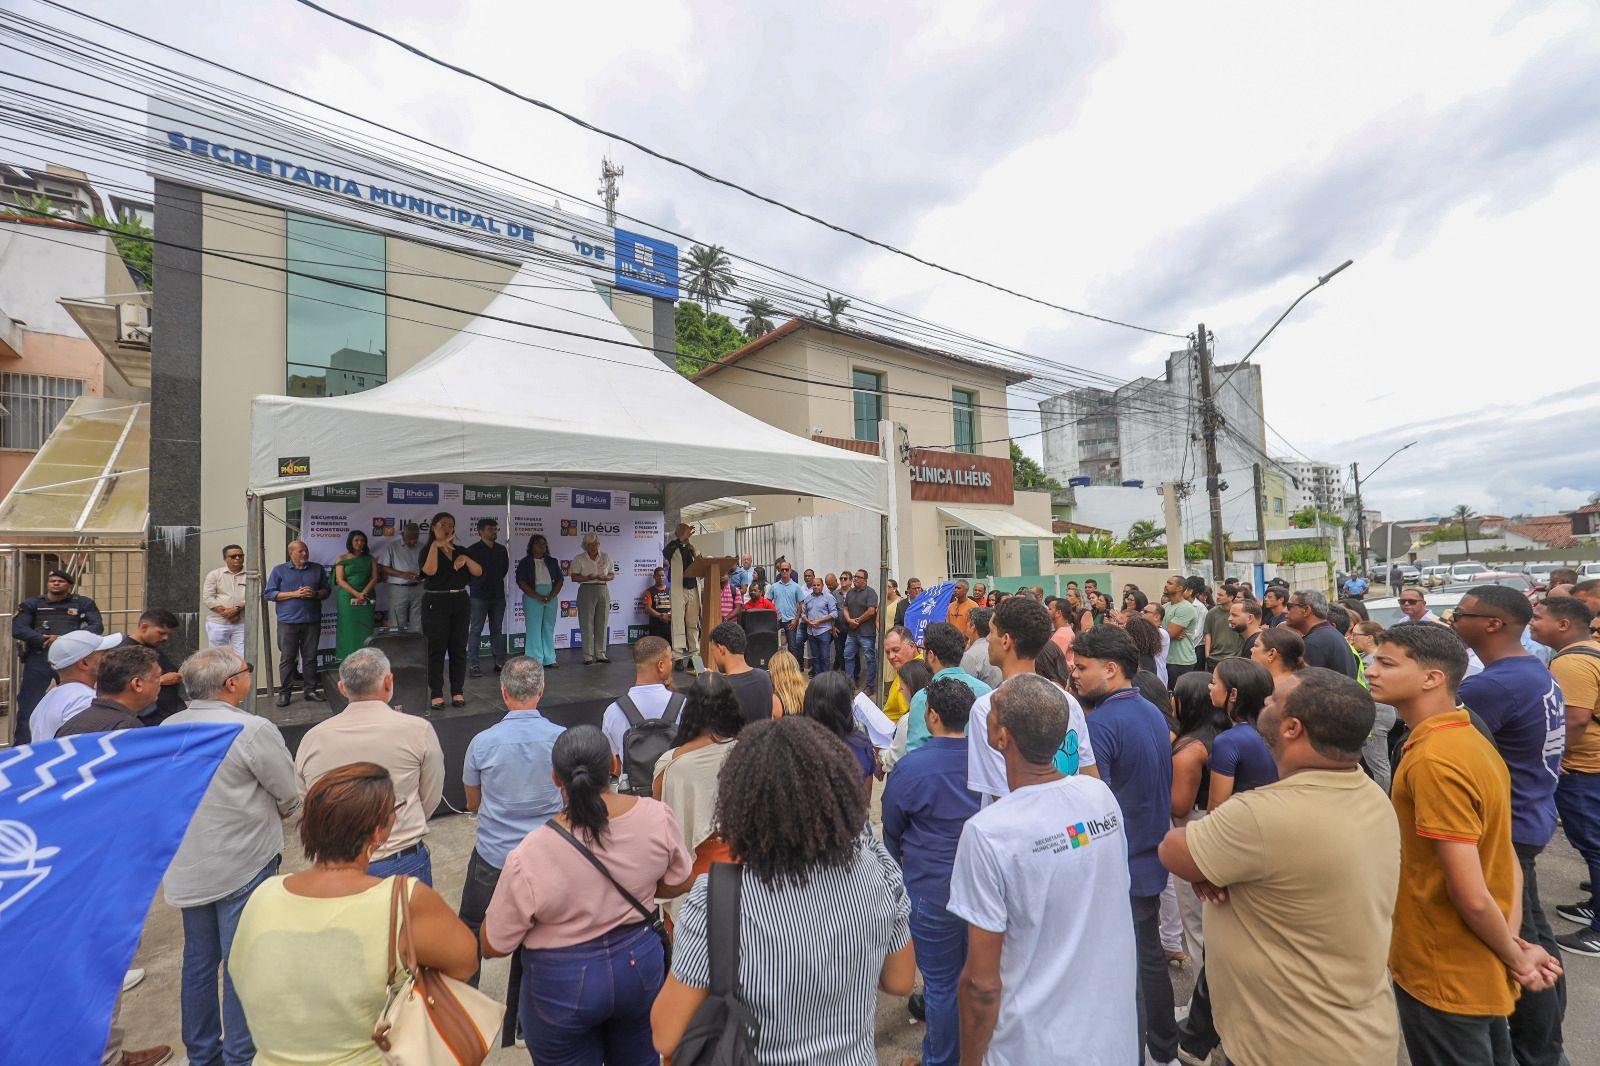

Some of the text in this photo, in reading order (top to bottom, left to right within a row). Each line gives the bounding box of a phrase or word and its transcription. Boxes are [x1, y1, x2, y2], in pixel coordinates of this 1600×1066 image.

[167, 131, 362, 198] SECRETARIA
[369, 184, 500, 233] MUNICIPAL
[507, 221, 535, 242] DE
[909, 460, 992, 487] CLÍNICA ILHÉUS
[326, 486, 357, 495] Ilhéus
[406, 489, 434, 497] Ilhéus
[580, 521, 620, 533] Ilhéus
[1086, 815, 1117, 836] Ilhéus
